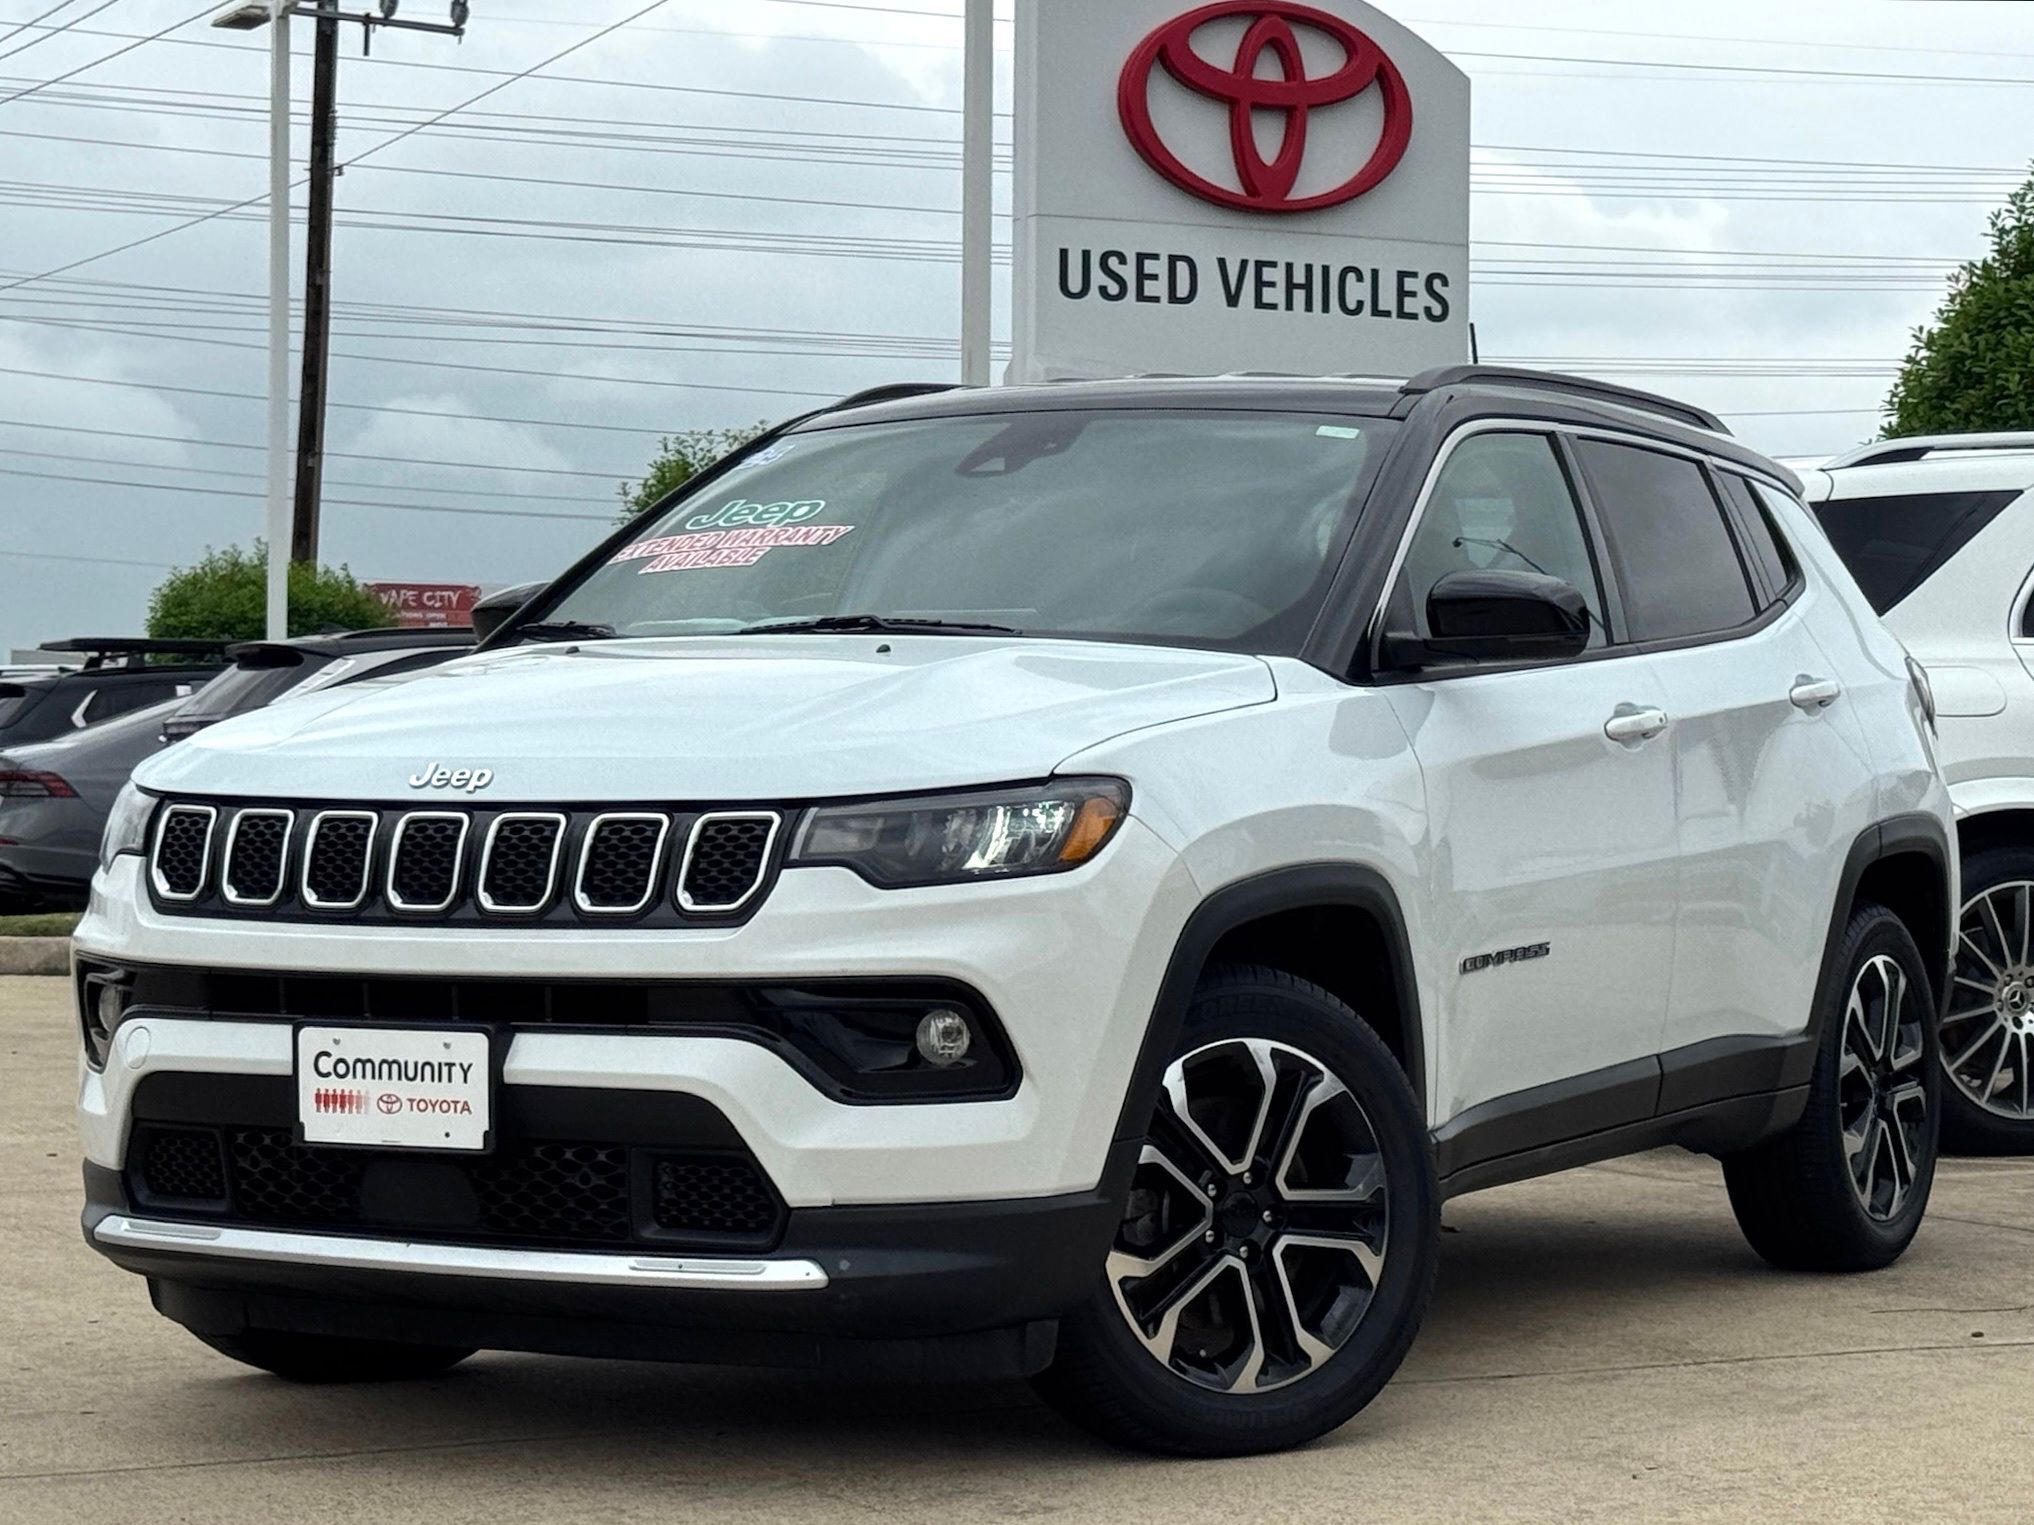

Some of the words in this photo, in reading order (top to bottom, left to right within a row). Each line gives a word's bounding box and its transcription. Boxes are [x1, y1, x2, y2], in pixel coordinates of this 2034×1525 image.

[1058, 247, 1199, 305] USED
[1216, 256, 1451, 324] VEHICLES
[685, 499, 827, 530] Jeep
[609, 532, 725, 565] EXTENDED
[717, 526, 854, 549] WARRANTY
[639, 547, 770, 574] AVAILABLE
[380, 588, 419, 607] VAPE
[423, 590, 461, 609] CITY
[408, 761, 495, 794] Jeep
[1459, 941, 1551, 976] COMPASS
[406, 1098, 473, 1116] TOYOTA
